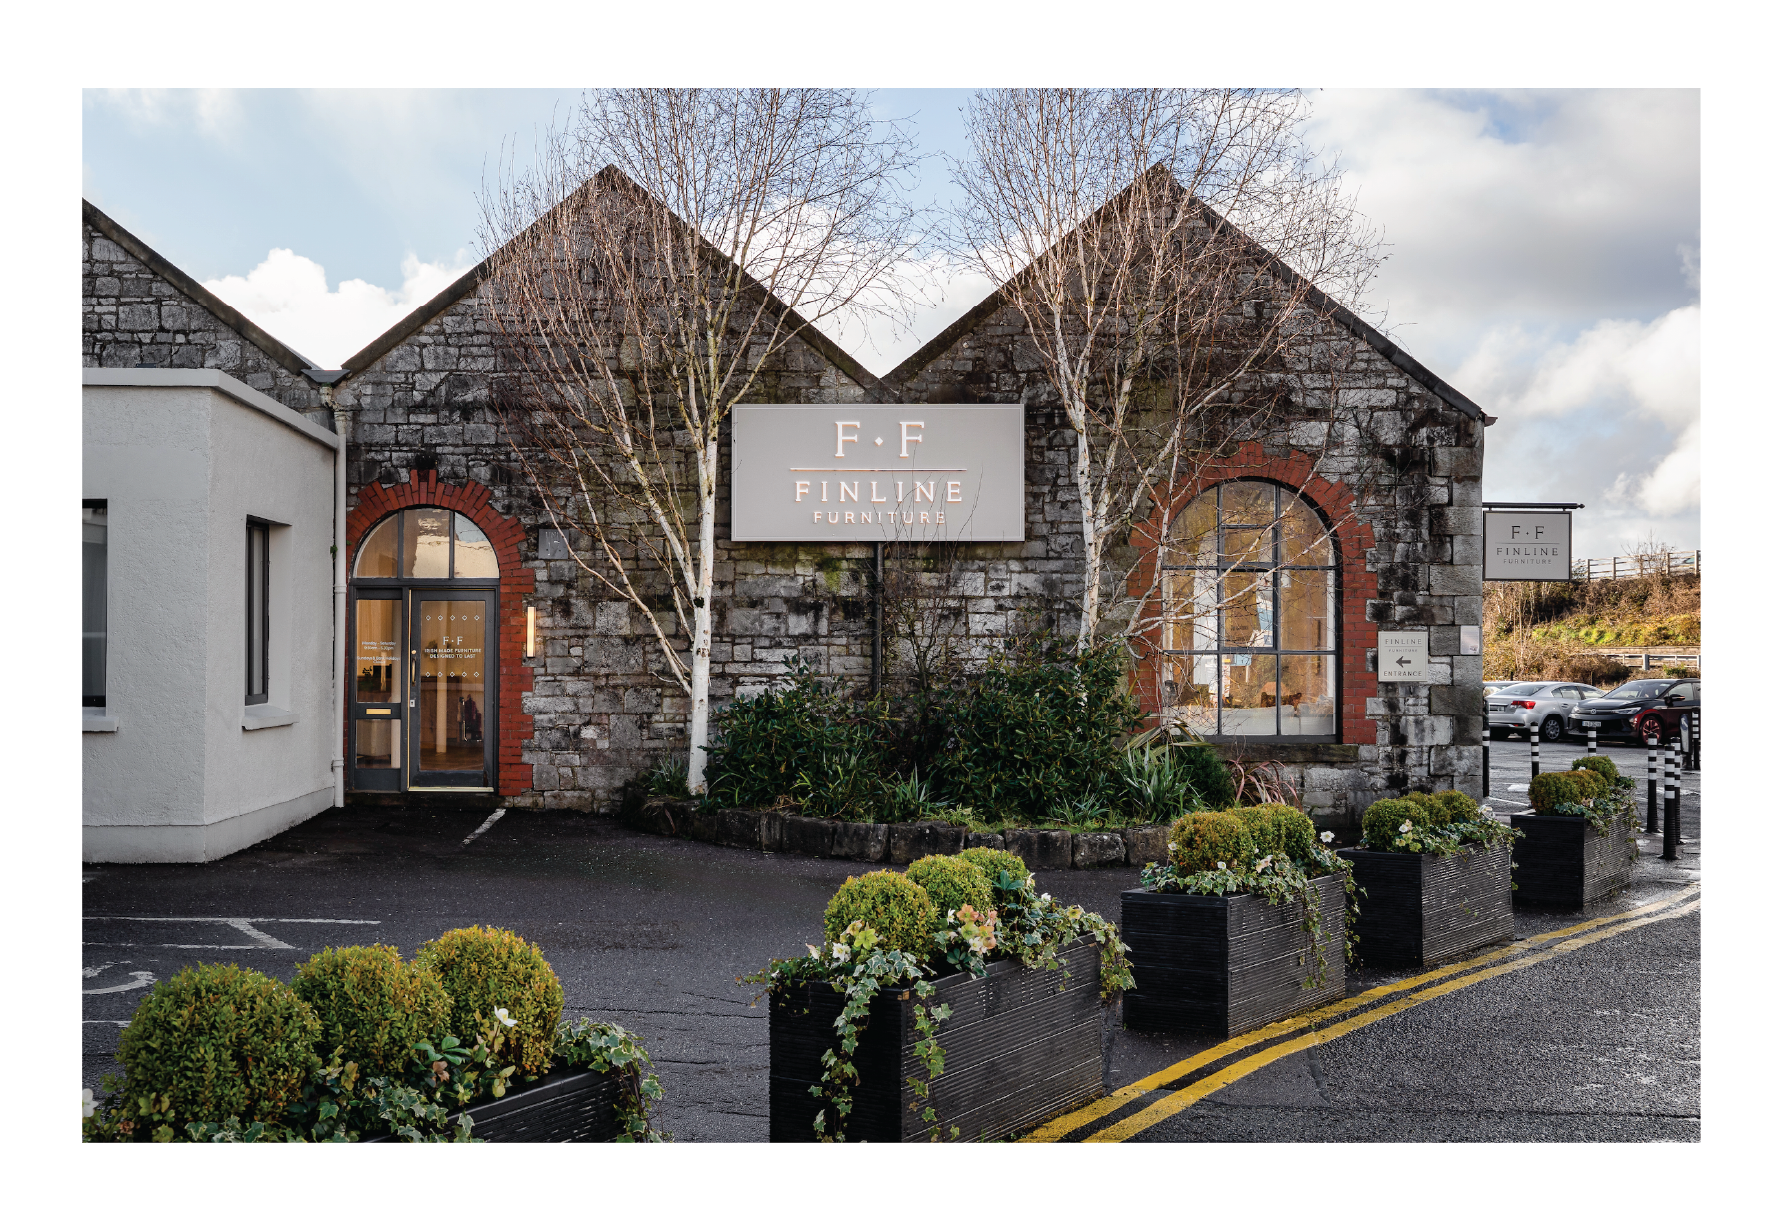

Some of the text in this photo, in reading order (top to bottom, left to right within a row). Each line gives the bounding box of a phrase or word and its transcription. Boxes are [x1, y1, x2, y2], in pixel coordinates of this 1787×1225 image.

[795, 481, 963, 503] FINLINE
[813, 511, 946, 524] FURNITURE
[1496, 547, 1559, 556] FINLINE
